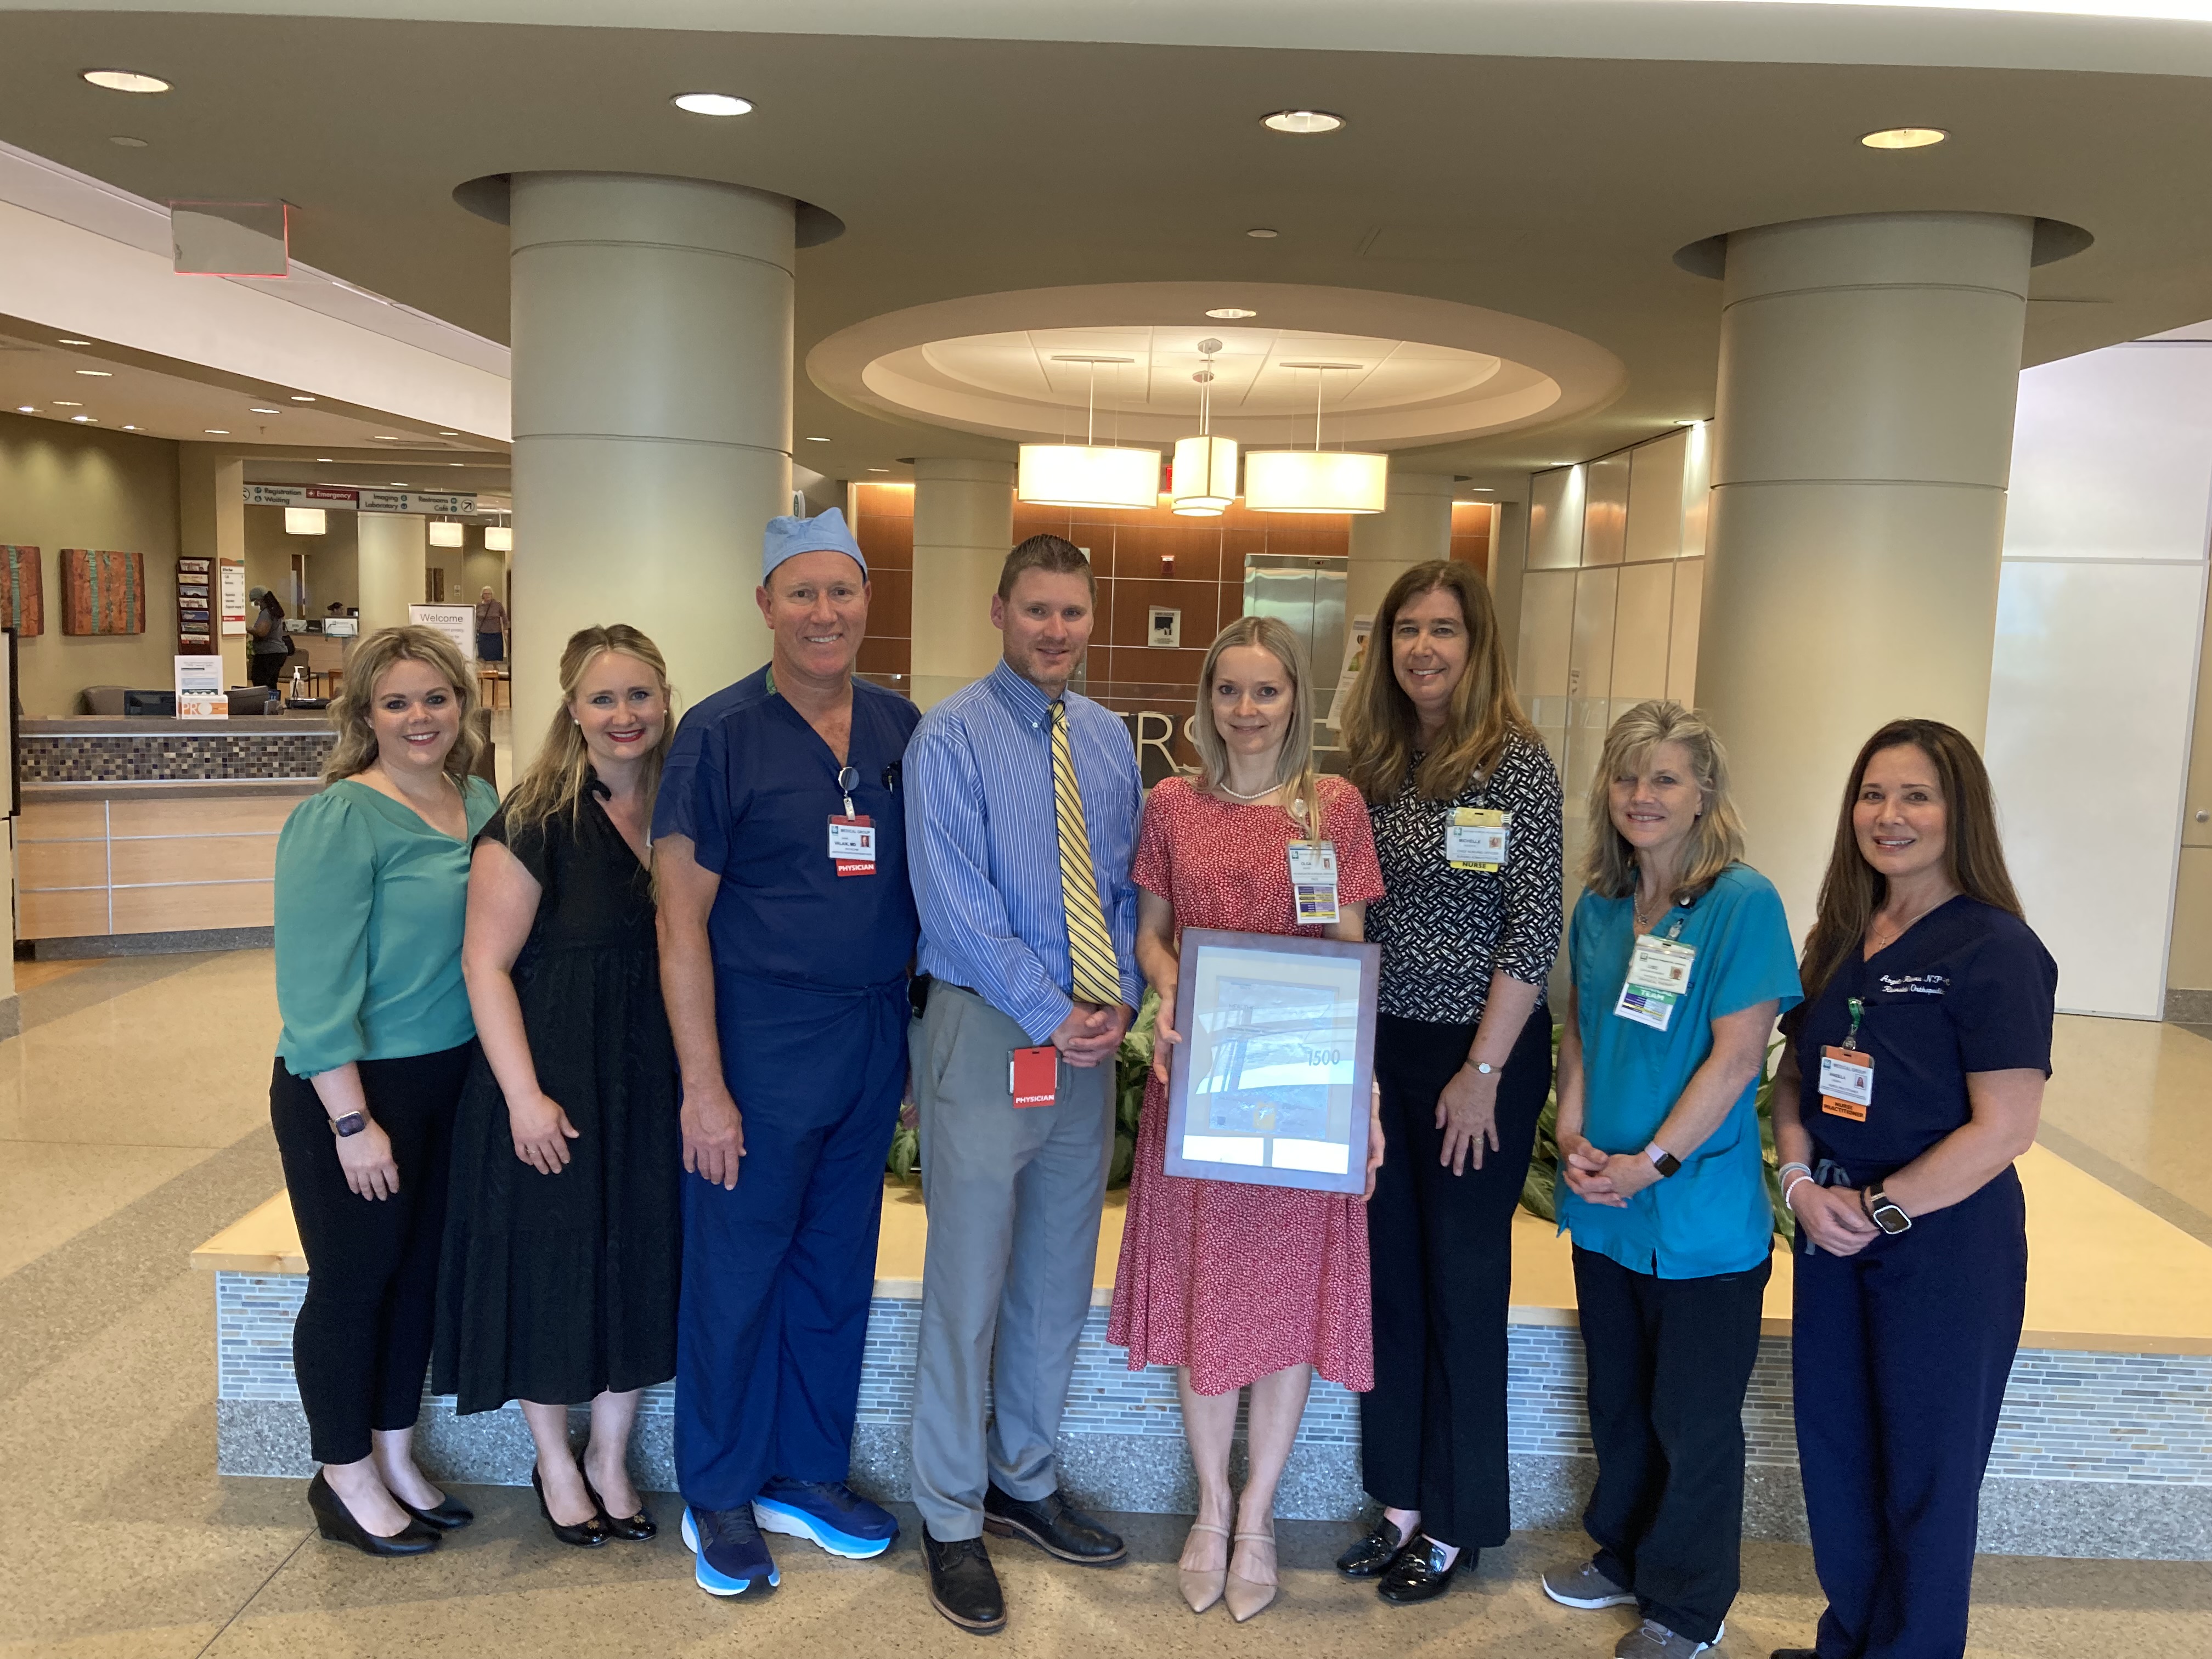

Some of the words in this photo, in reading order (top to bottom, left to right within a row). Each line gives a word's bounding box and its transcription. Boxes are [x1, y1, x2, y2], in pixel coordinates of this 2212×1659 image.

[264, 488, 301, 496] Registration
[317, 490, 351, 500] Emergency
[373, 494, 398, 502] Imaging
[365, 501, 398, 510] Laboratory
[420, 613, 463, 623] Welcome
[838, 864, 874, 872] PHYSICIAN
[1307, 1049, 1340, 1066] 1500
[1015, 1094, 1054, 1103] PHYSICIAN
